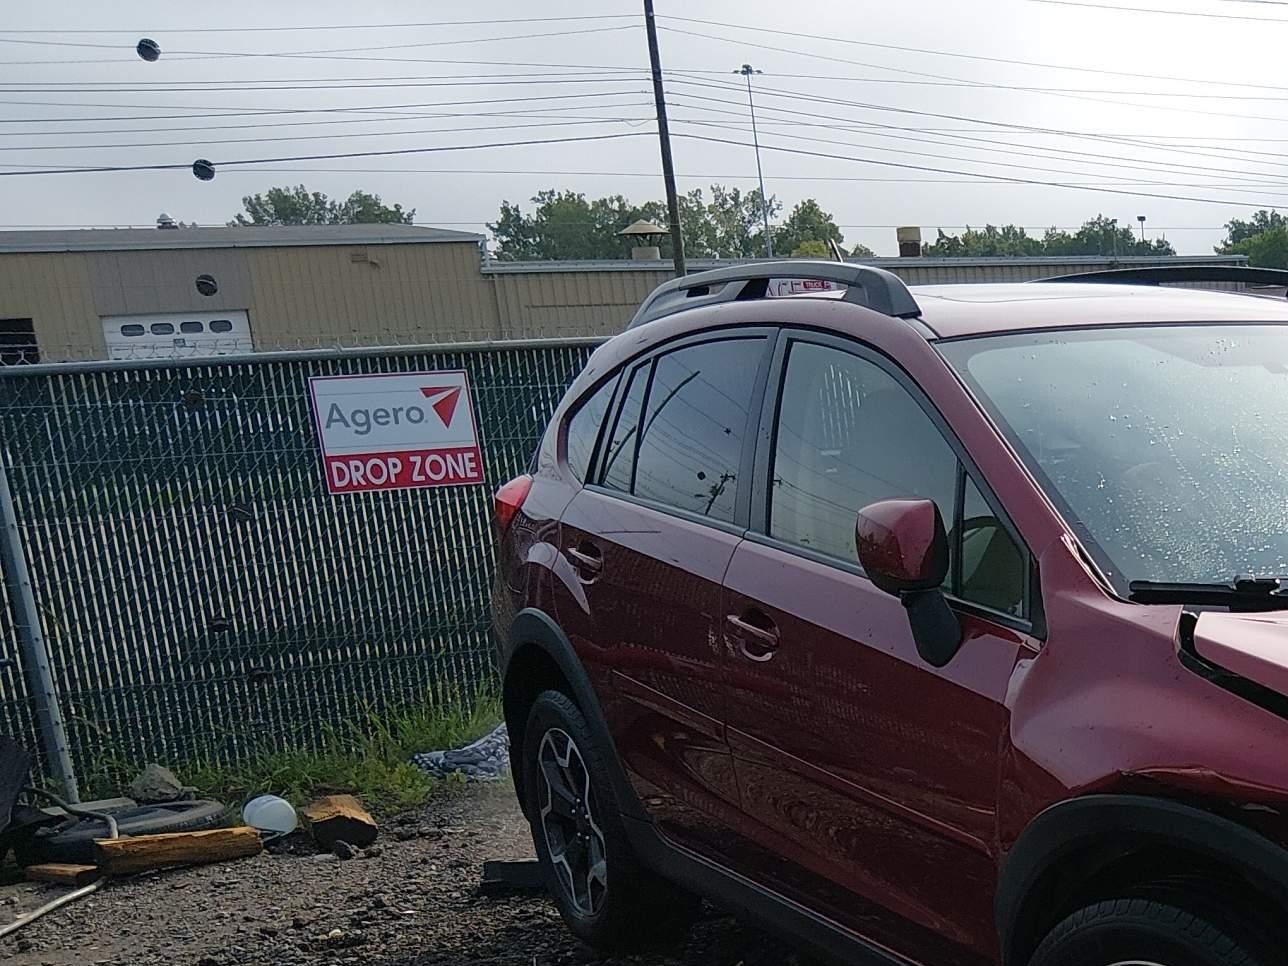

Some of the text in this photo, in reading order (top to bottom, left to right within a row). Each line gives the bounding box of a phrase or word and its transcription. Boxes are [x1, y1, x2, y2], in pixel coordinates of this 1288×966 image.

[325, 402, 425, 435] Agero
[330, 452, 479, 488] DROP ZONE
